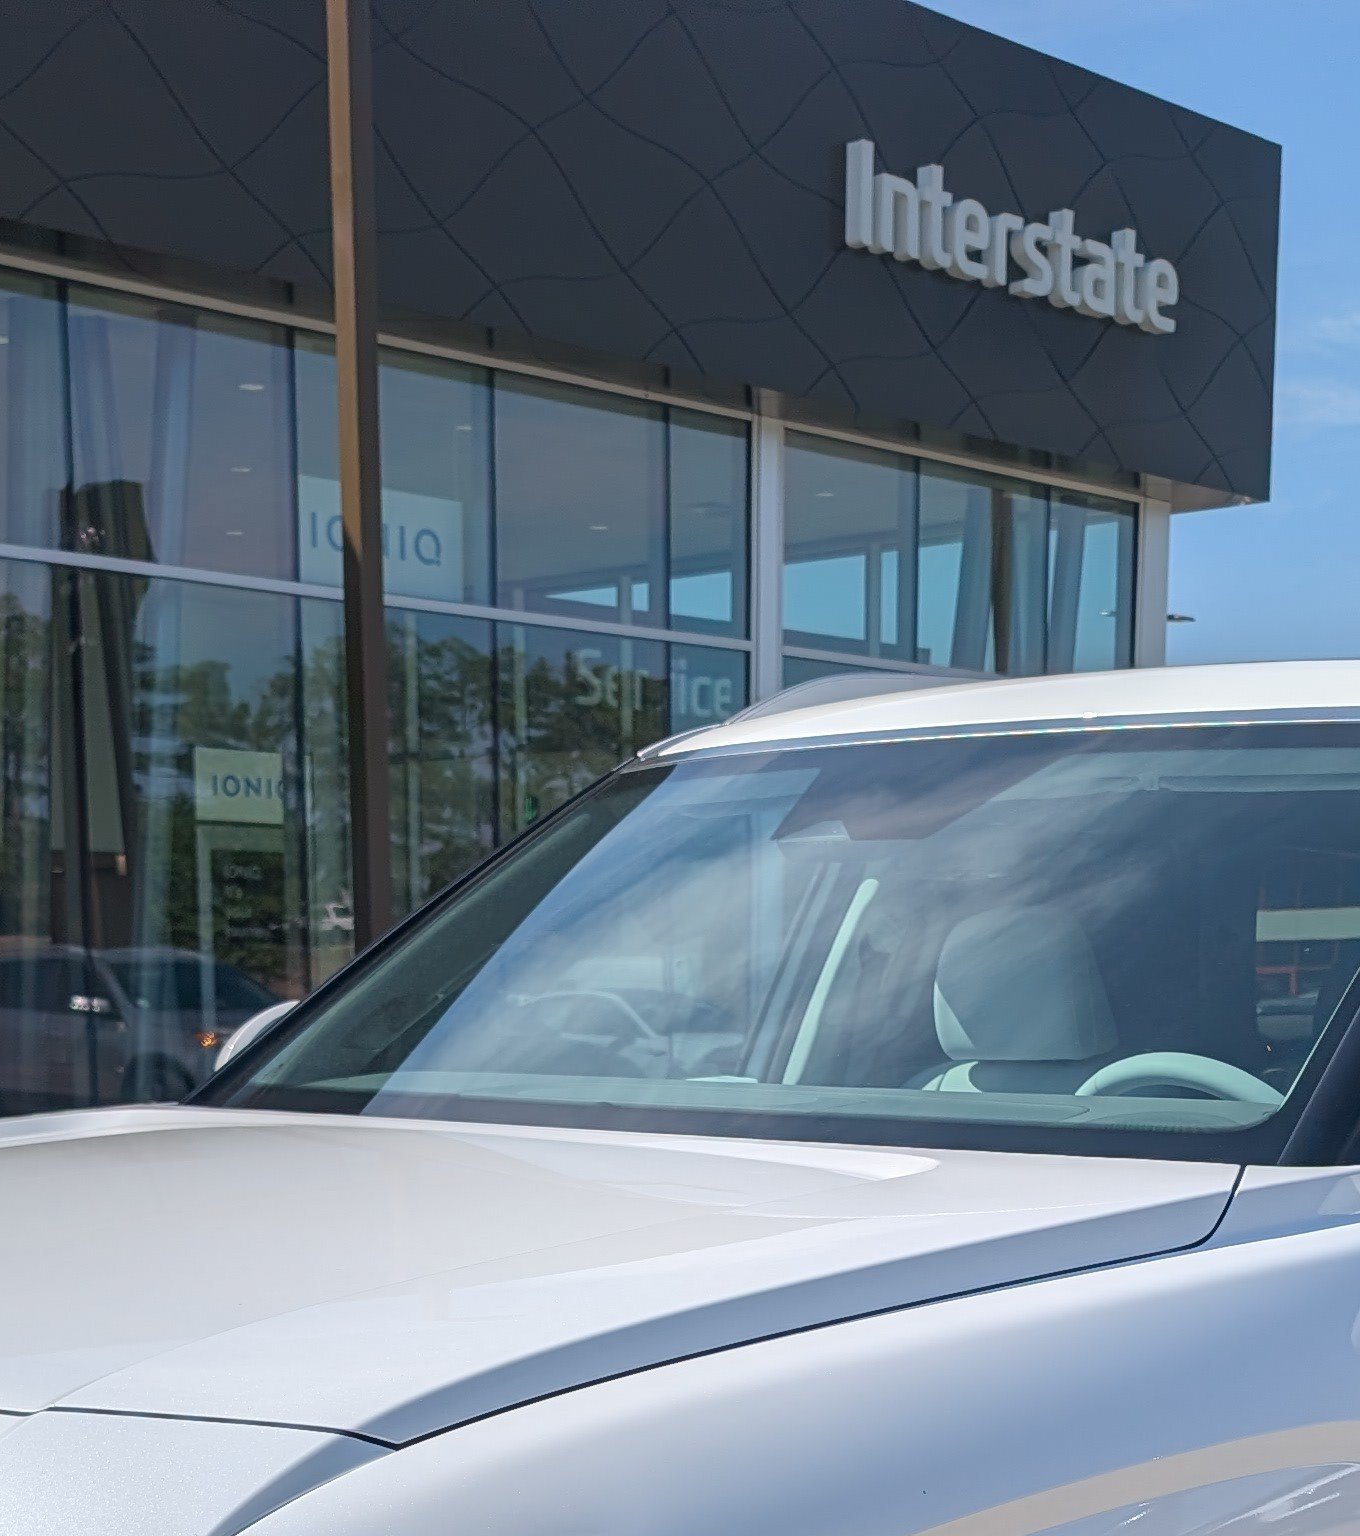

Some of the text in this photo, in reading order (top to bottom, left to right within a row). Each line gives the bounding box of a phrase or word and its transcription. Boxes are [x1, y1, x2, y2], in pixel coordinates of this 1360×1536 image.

[845, 139, 1179, 335] Interstate
[311, 512, 443, 566] IOIQ
[574, 648, 733, 718] Serice
